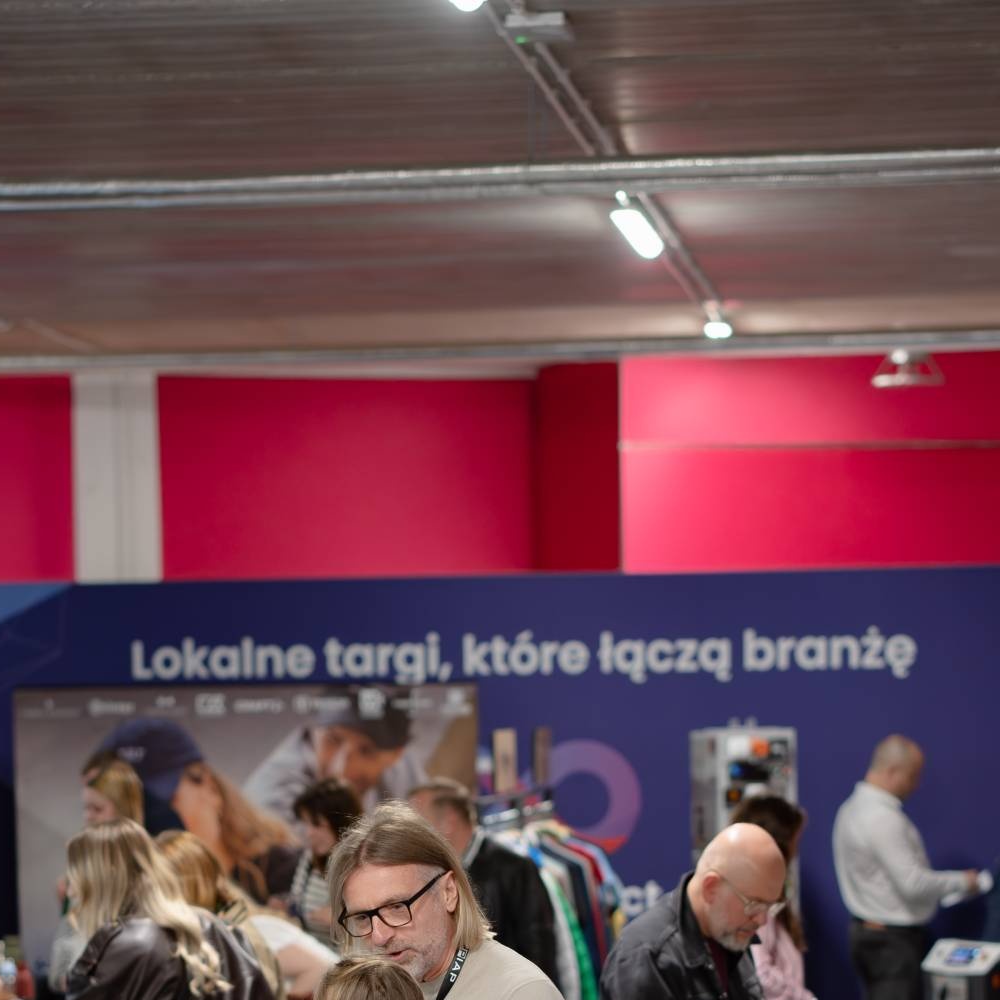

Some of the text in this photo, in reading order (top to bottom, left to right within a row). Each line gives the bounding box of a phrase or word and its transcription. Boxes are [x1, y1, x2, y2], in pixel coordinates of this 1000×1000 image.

[131, 625, 917, 684] Lokalne targi, które łączą branżę
